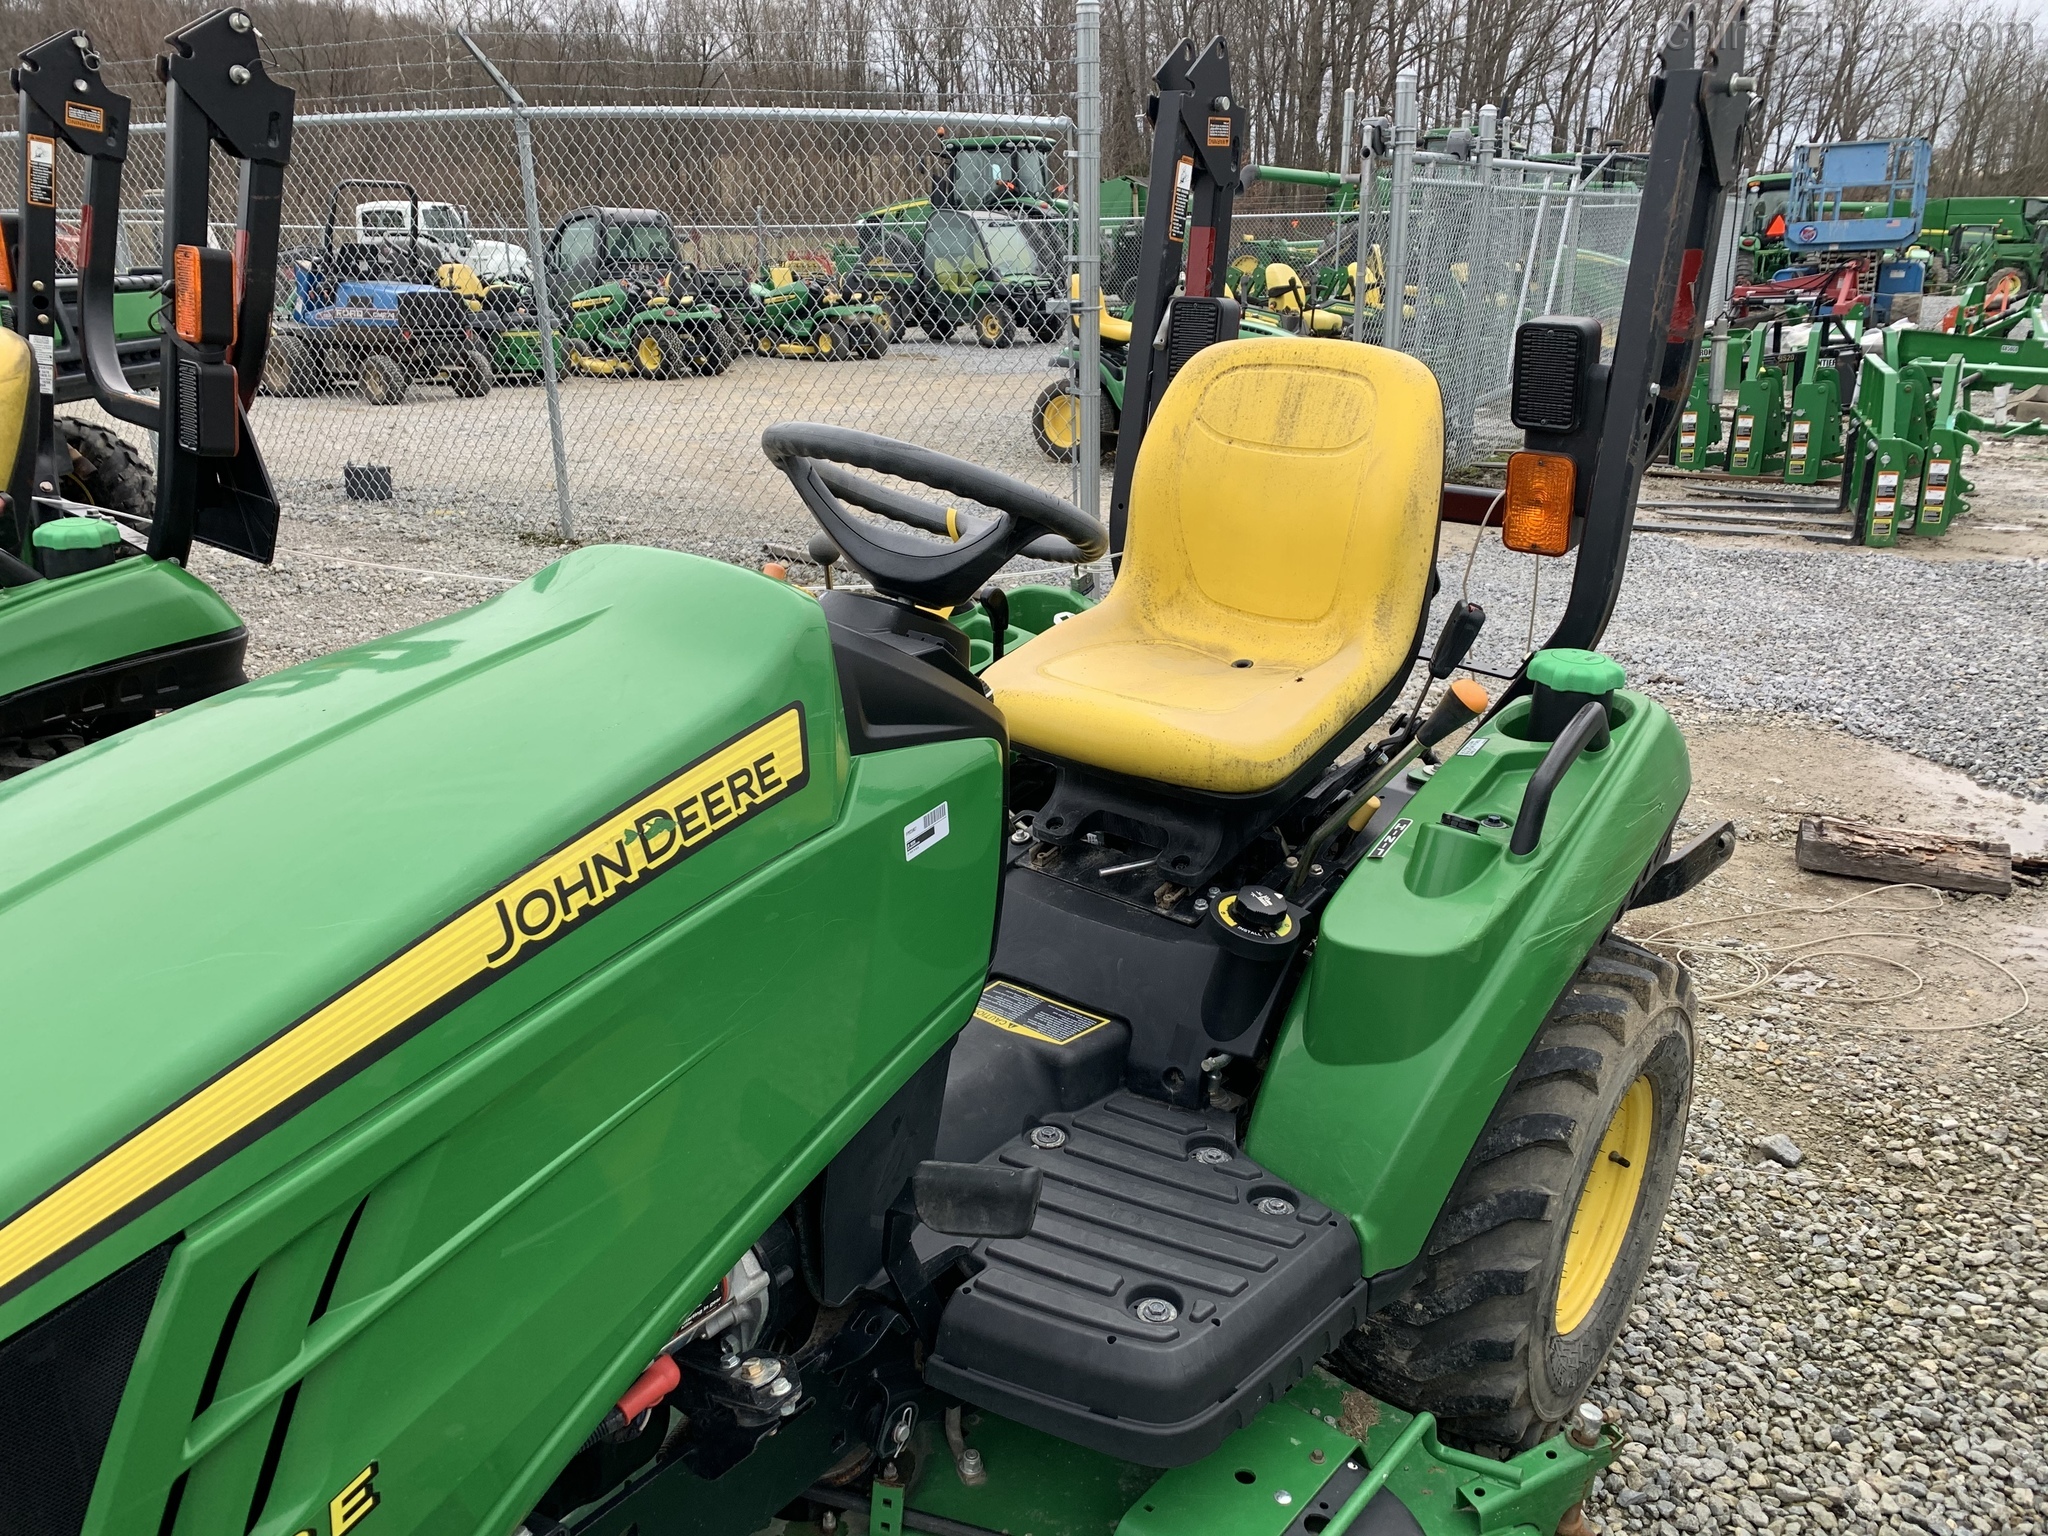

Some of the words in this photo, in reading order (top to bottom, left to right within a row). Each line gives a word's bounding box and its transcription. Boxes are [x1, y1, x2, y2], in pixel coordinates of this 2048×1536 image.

[486, 840, 632, 965] JOHN
[634, 752, 783, 864] DEERE
[1237, 925, 1262, 938] INSTALL
[976, 1009, 1009, 1027] CAUTIO
